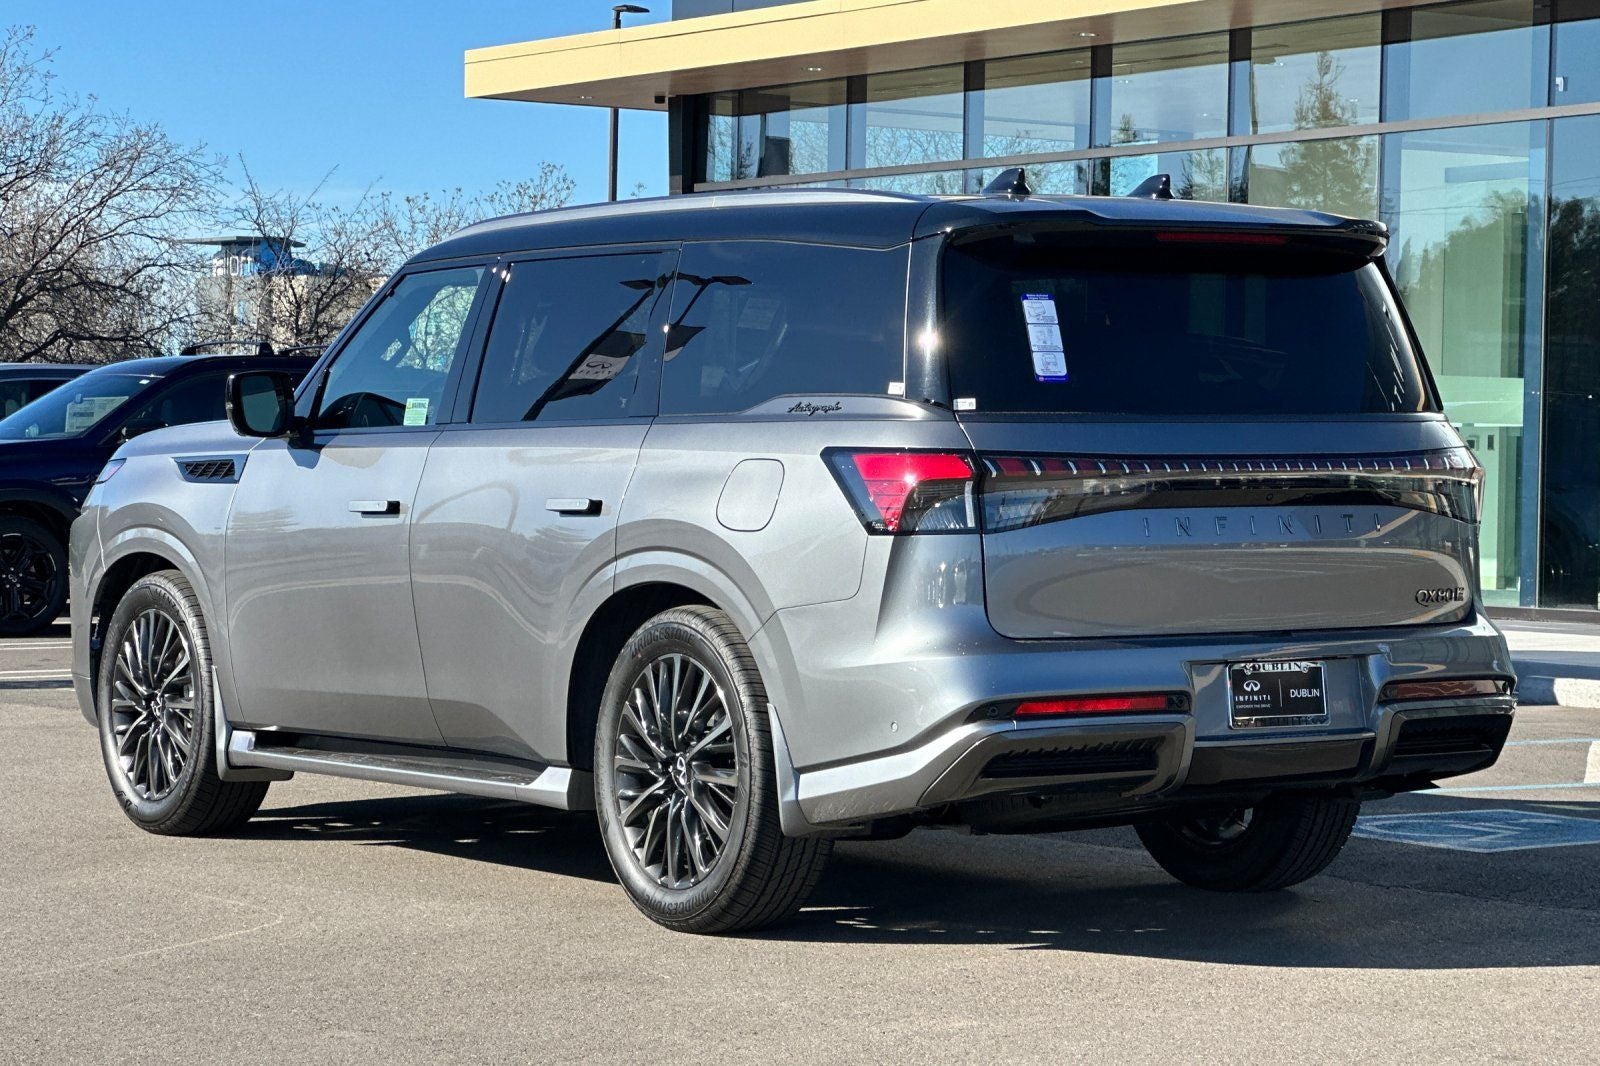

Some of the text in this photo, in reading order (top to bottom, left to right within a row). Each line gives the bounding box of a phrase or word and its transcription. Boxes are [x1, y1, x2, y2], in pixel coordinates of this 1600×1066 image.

[787, 402, 842, 416] Autograph
[1143, 513, 1381, 537] INFINITI
[1252, 662, 1302, 671] DUBLIN
[1290, 689, 1320, 698] DUBLIN
